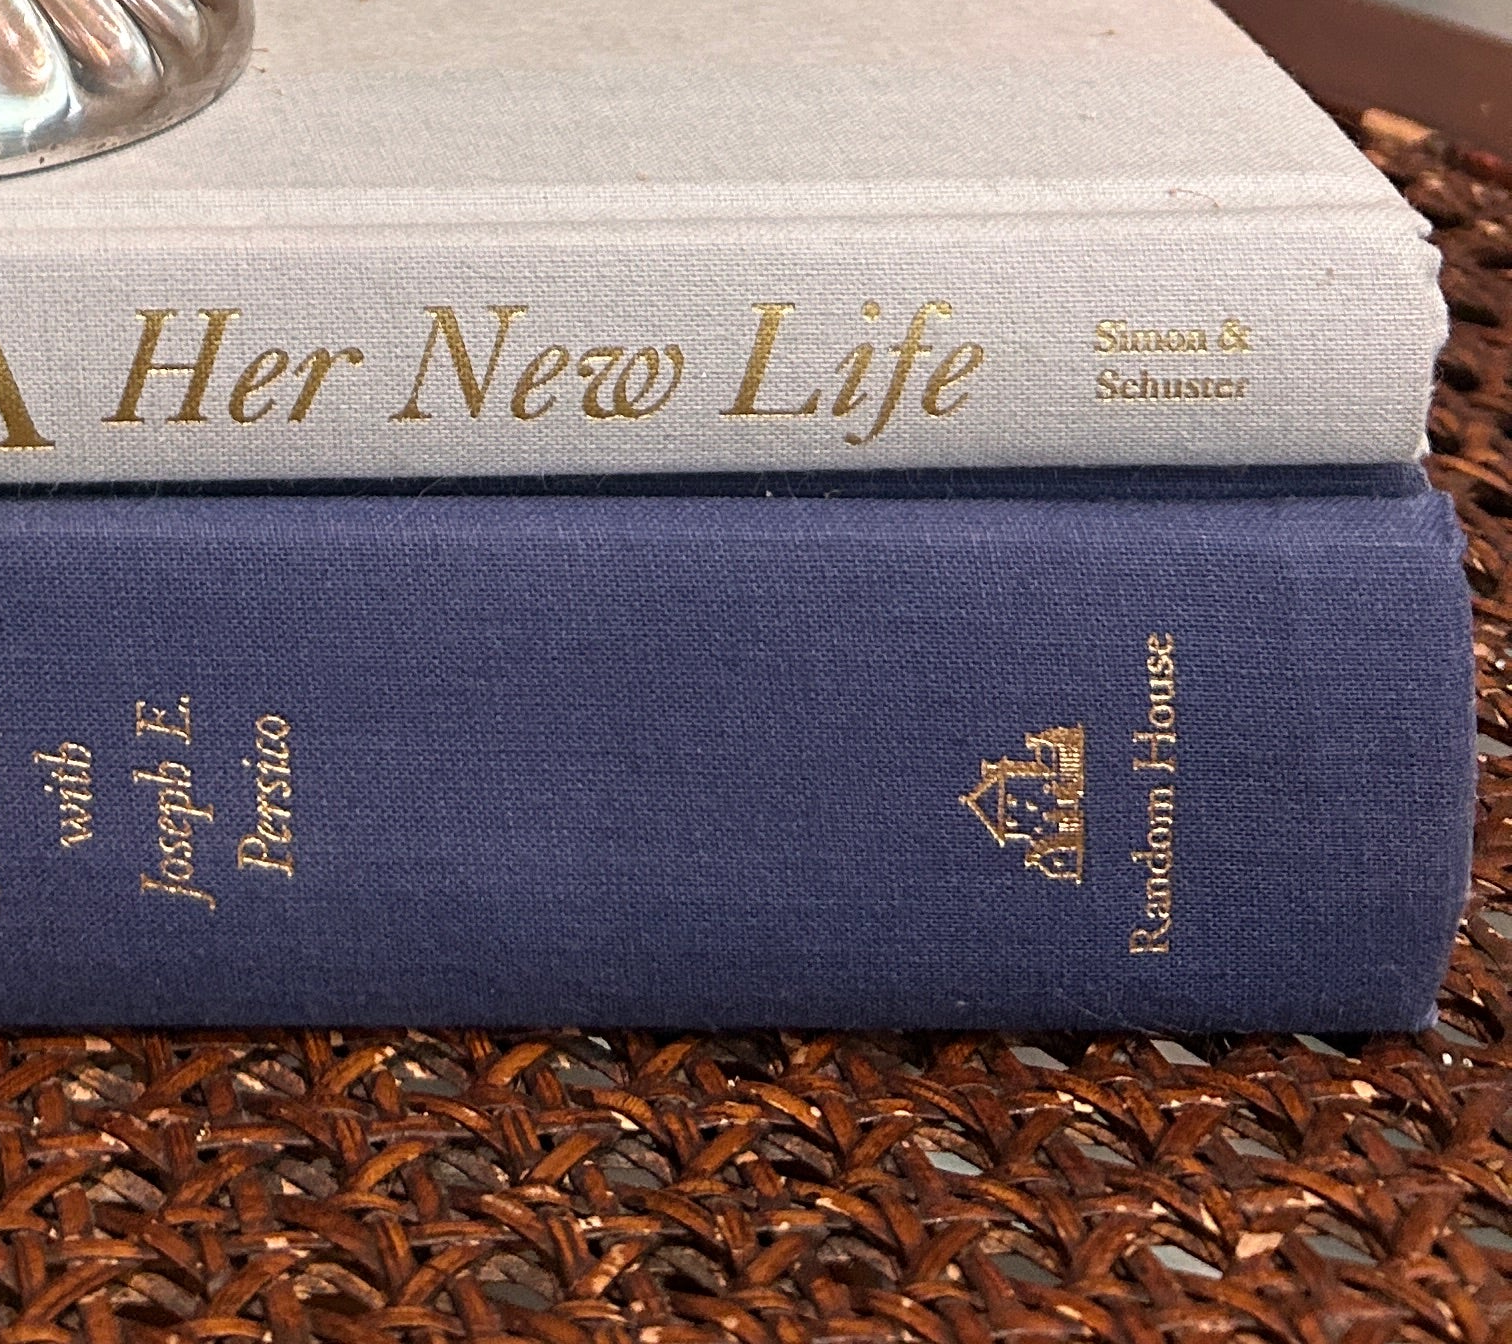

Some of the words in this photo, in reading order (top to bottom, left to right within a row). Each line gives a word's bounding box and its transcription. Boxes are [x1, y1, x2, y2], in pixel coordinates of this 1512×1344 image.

[101, 304, 364, 426] Her
[389, 304, 684, 423] New
[720, 299, 986, 446] Life
[1094, 318, 1207, 356] Simon
[1215, 318, 1252, 354] &
[1094, 364, 1250, 402] Schuster
[136, 695, 190, 744] E.
[1133, 632, 1178, 772] House
[34, 741, 93, 847] with
[132, 760, 216, 910] Joseph
[237, 713, 294, 877] Persico
[1129, 785, 1175, 955] Random
